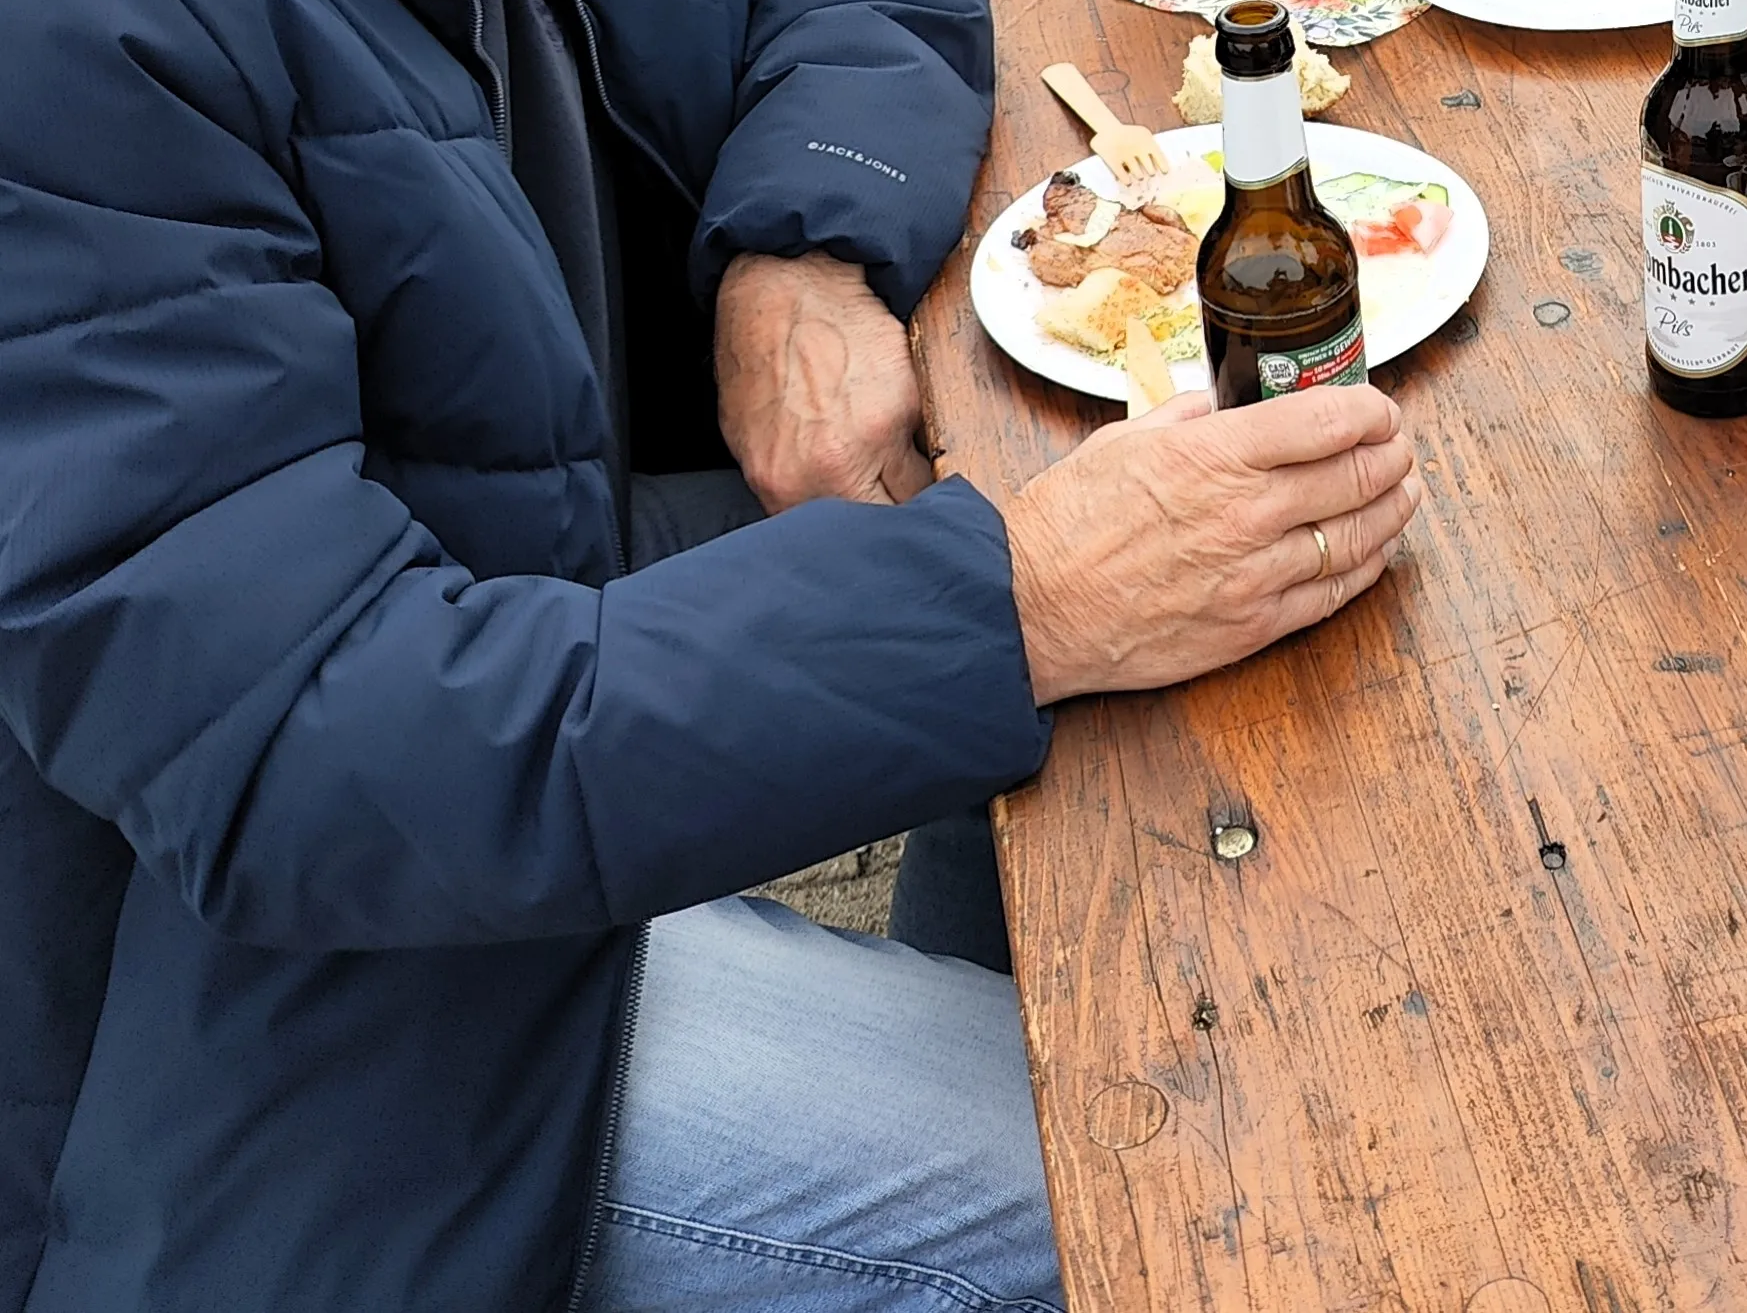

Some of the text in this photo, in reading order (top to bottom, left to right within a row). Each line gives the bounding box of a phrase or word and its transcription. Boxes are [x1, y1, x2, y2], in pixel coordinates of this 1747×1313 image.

[1695, 240, 1716, 248] 1803
[1654, 306, 1694, 337] Pils
[1268, 362, 1291, 373] CASH
